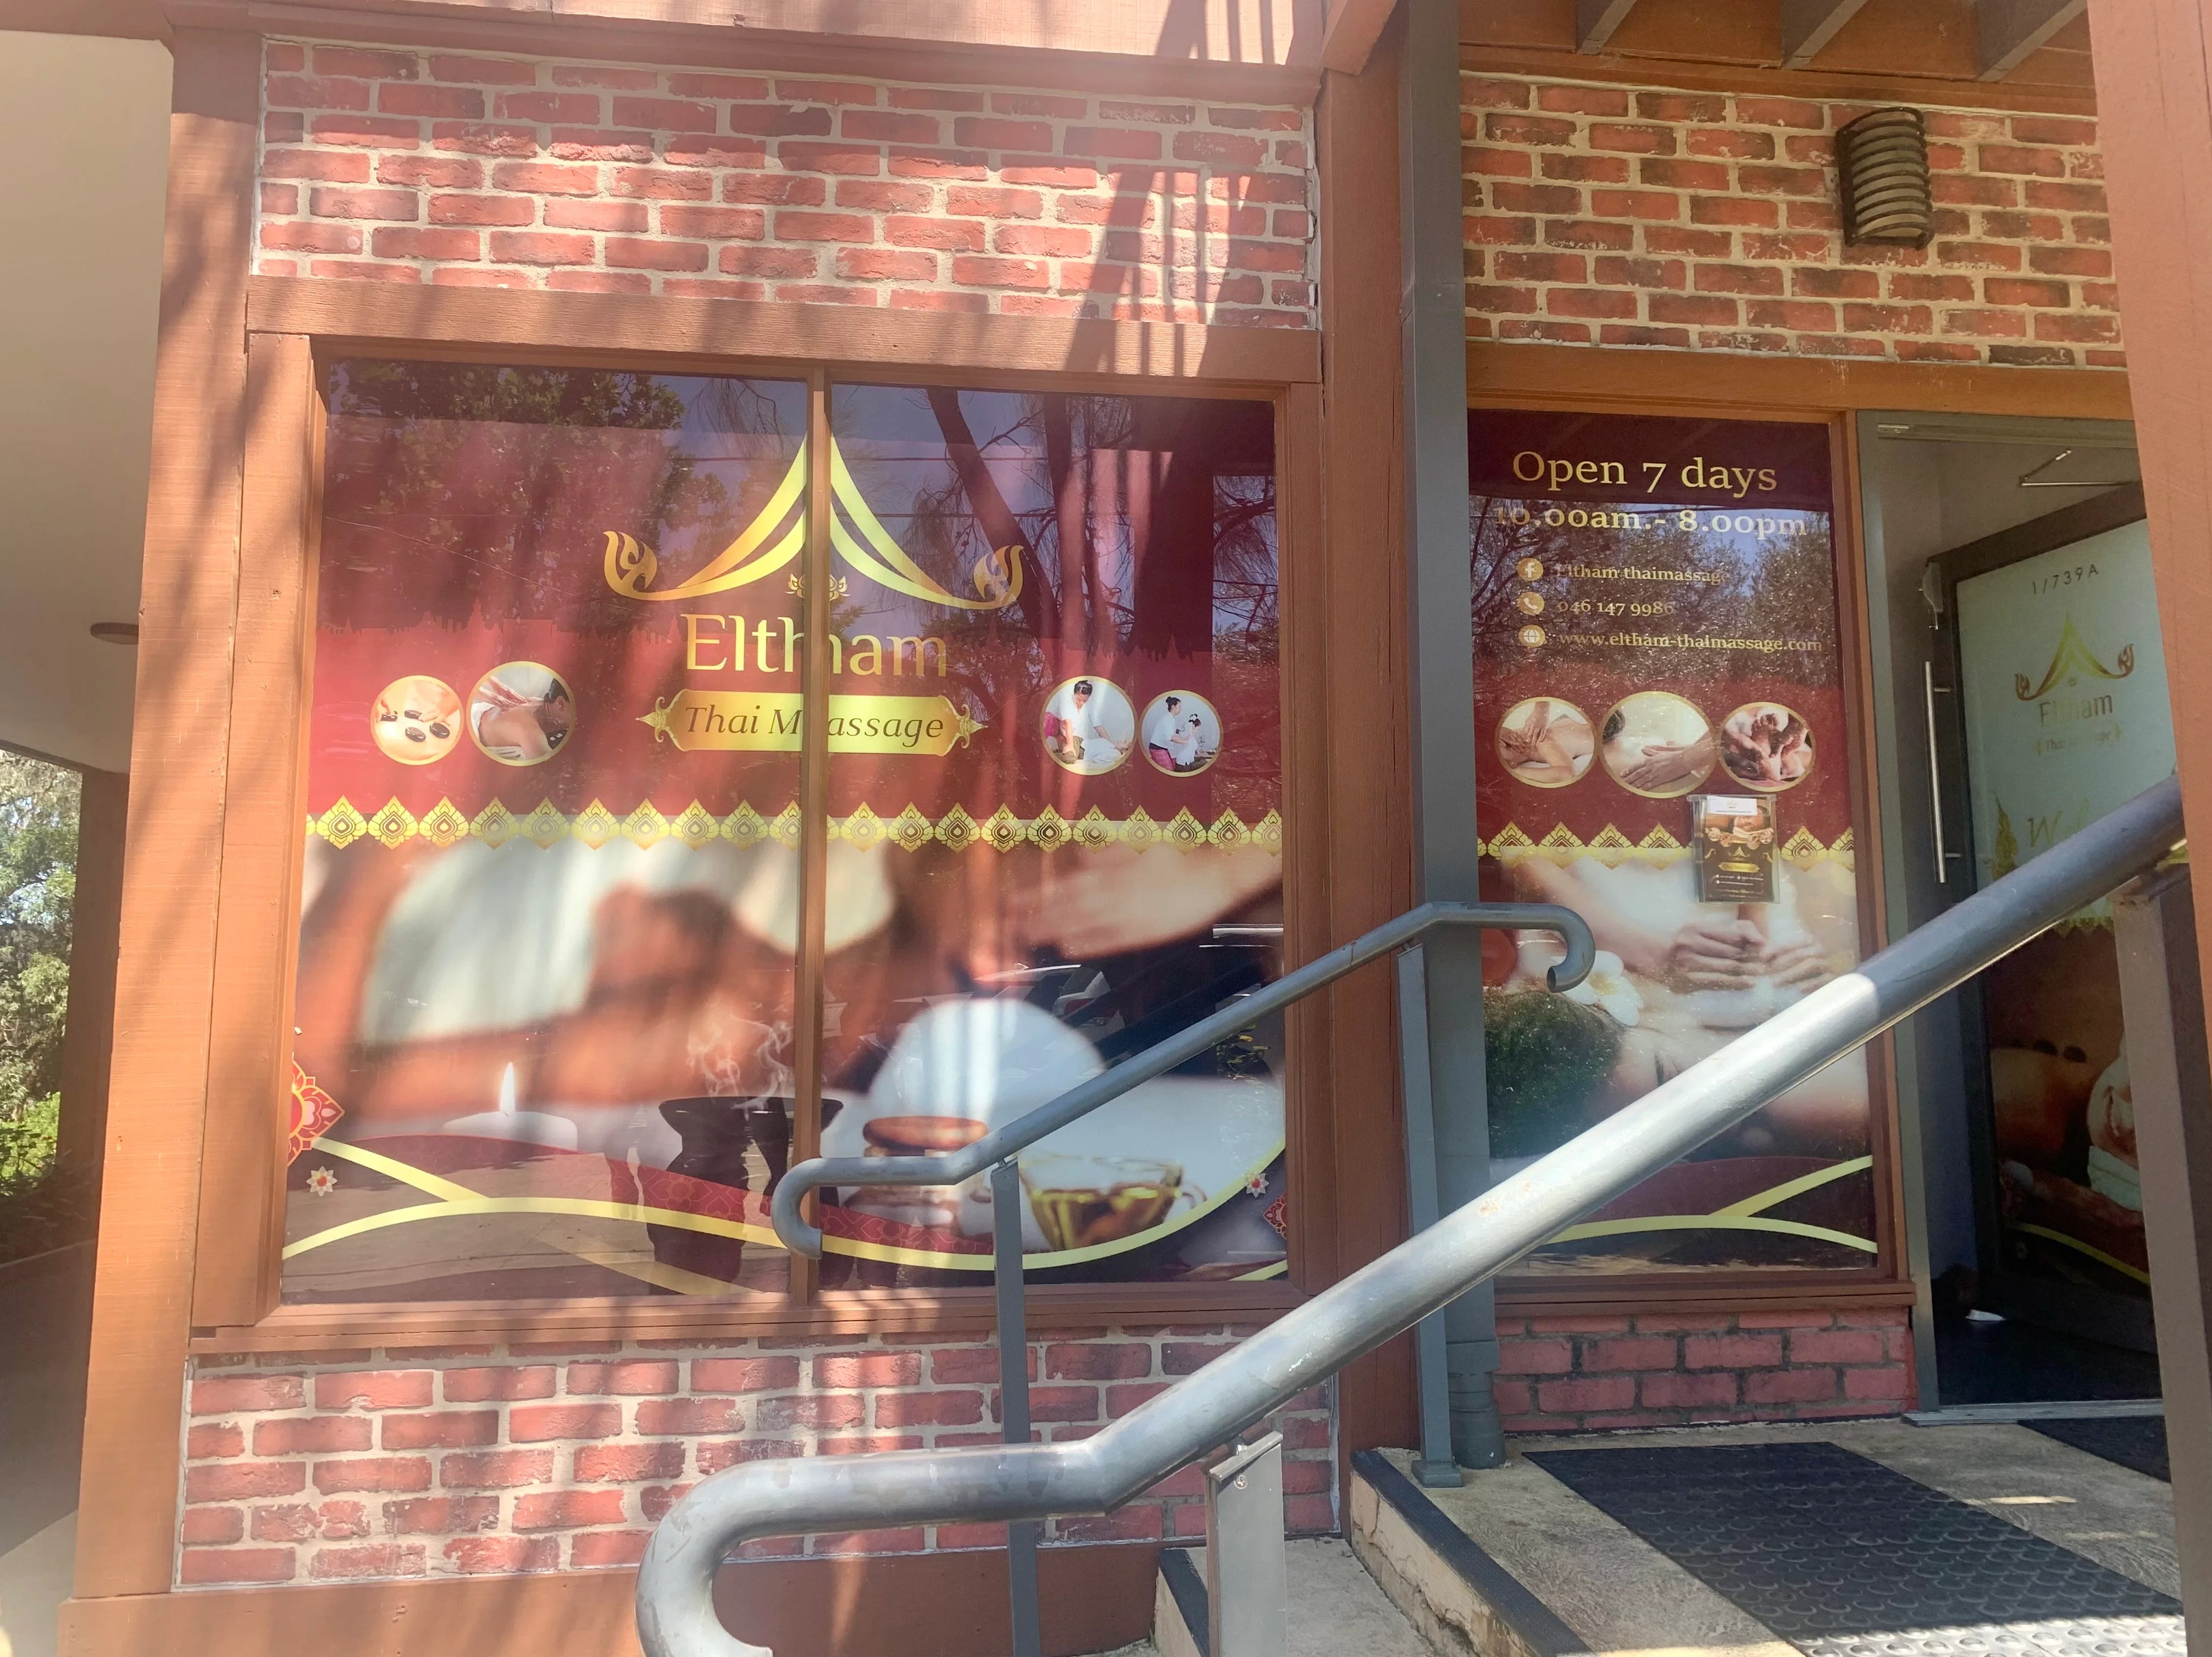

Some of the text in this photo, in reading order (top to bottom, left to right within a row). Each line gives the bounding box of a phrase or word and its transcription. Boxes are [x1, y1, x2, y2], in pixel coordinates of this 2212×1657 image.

[1512, 451, 1778, 498] Open 7 days
[1678, 509, 1808, 540] 8.00pm
[1556, 563, 1618, 579] Eltham
[1623, 566, 1730, 585] thaimassage
[2032, 563, 2099, 595] 1/739A
[1557, 598, 1675, 617] 046 147 9986
[680, 613, 946, 677] Eltham
[1559, 633, 1823, 654] www.eltham-thaimassage.com
[685, 703, 944, 748] Thai Massage
